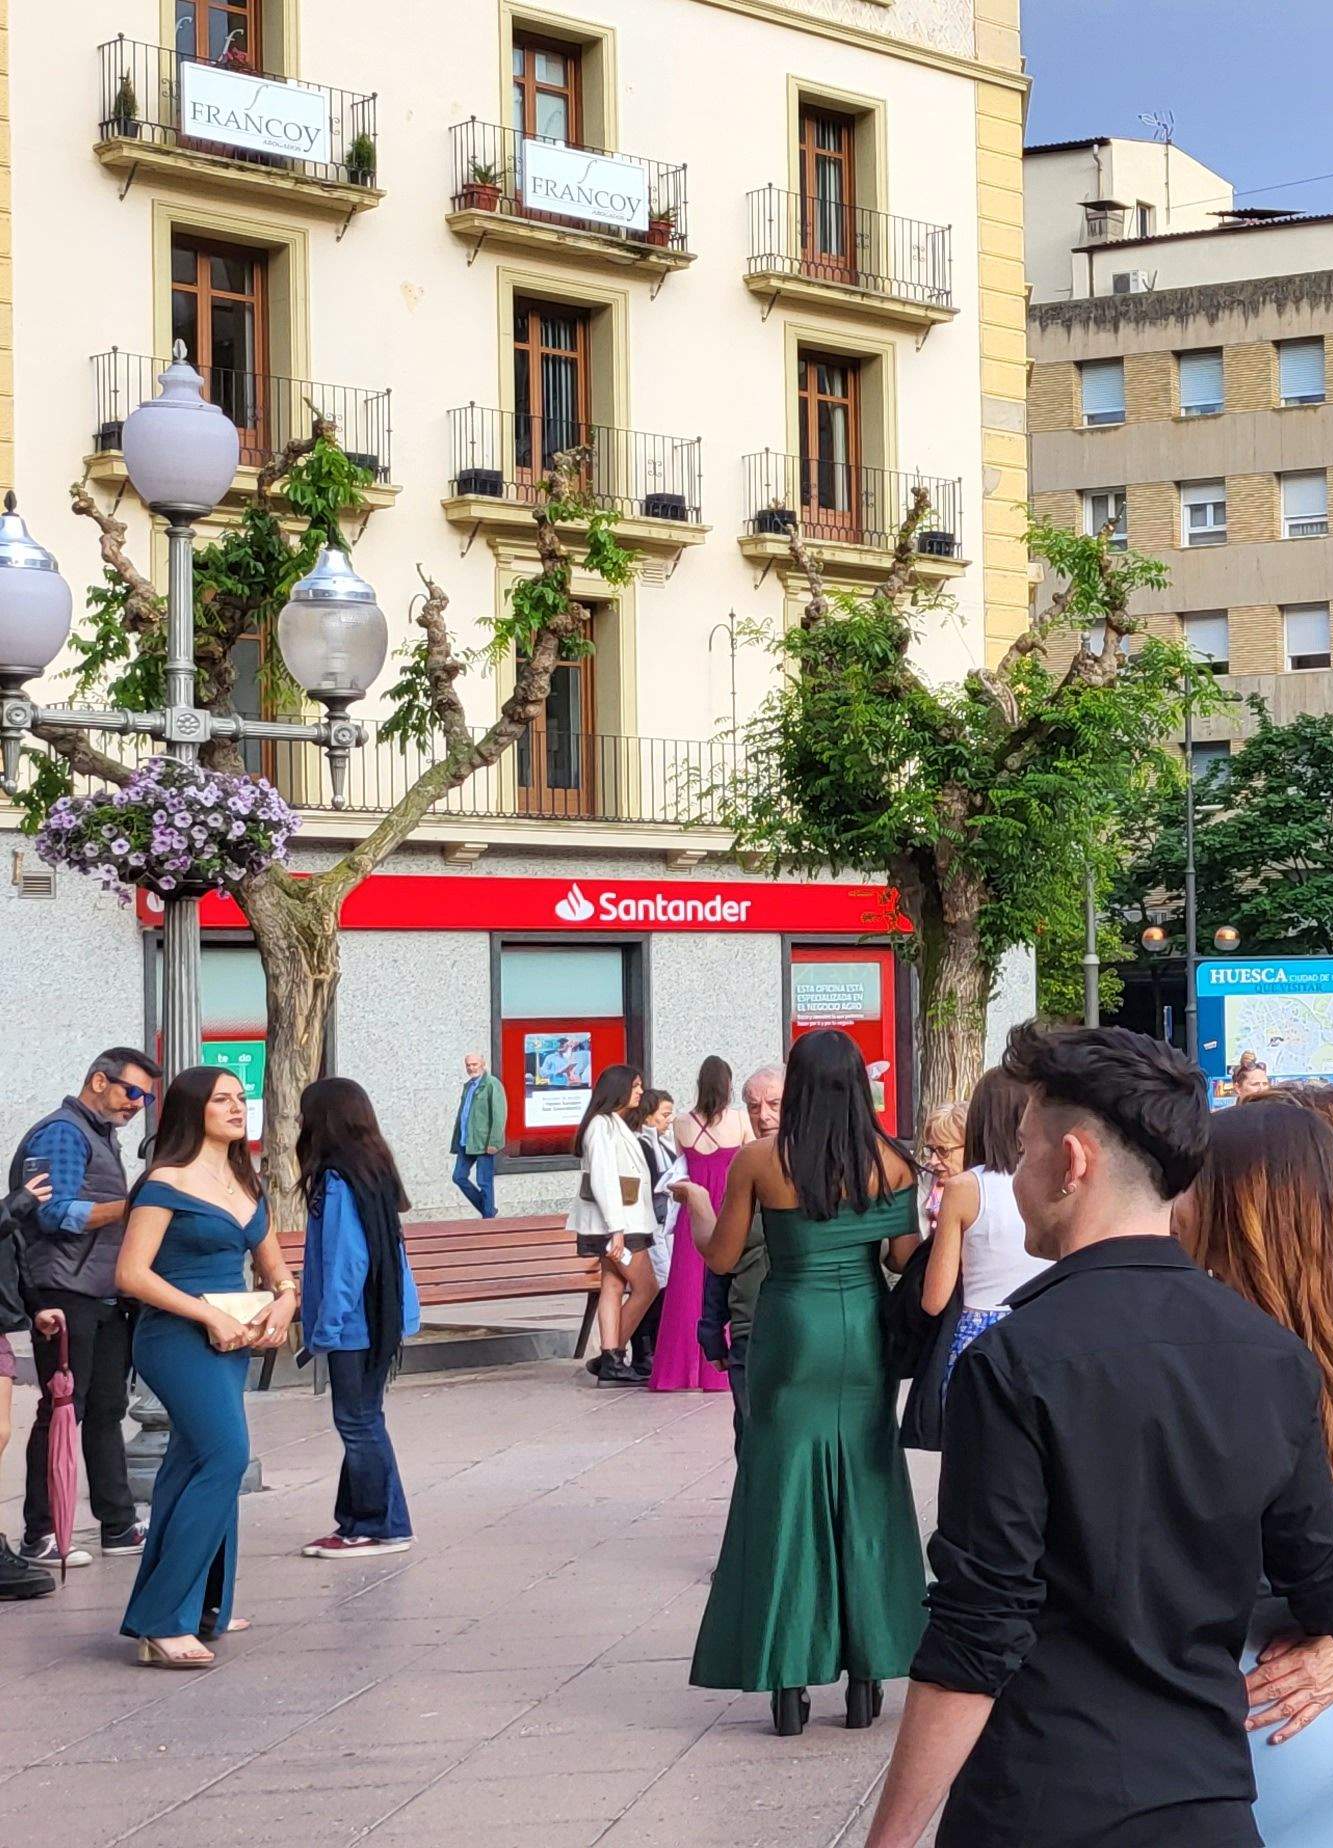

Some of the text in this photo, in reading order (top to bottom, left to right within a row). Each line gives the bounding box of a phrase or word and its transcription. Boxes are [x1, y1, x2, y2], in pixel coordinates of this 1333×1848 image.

[600, 892, 751, 922] Santander
[1210, 968, 1289, 984] HUESCA
[1289, 974, 1317, 984] CIUDAD
[1319, 974, 1330, 982] DE
[797, 984, 815, 993] ESTA
[816, 984, 845, 993] OFICINA
[797, 994, 852, 1003] ESPECIALIZADA
[807, 1003, 841, 1011] NEGOCIO
